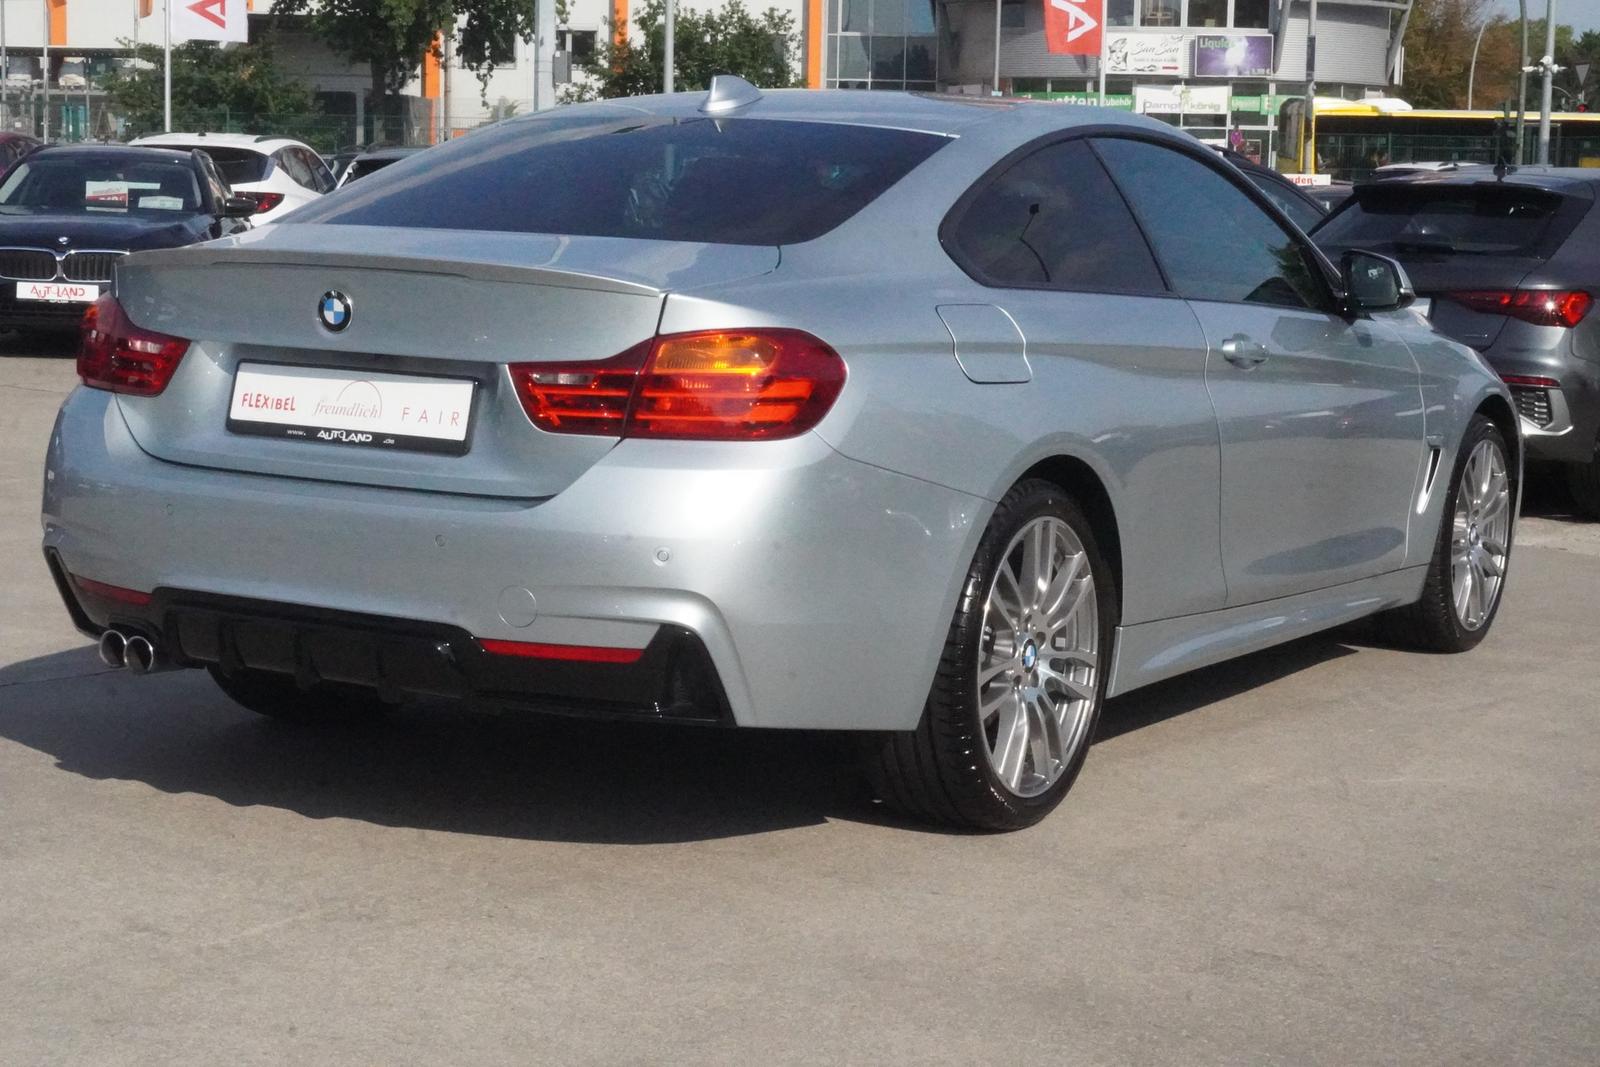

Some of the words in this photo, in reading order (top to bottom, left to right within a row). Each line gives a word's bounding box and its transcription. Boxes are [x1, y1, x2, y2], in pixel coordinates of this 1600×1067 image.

[31, 285, 85, 299] AUTOLAND
[241, 392, 296, 412] FLEXIBEL
[313, 401, 380, 419] freundlich
[401, 407, 460, 426] FAIR
[317, 429, 373, 443] AUTOLAND
